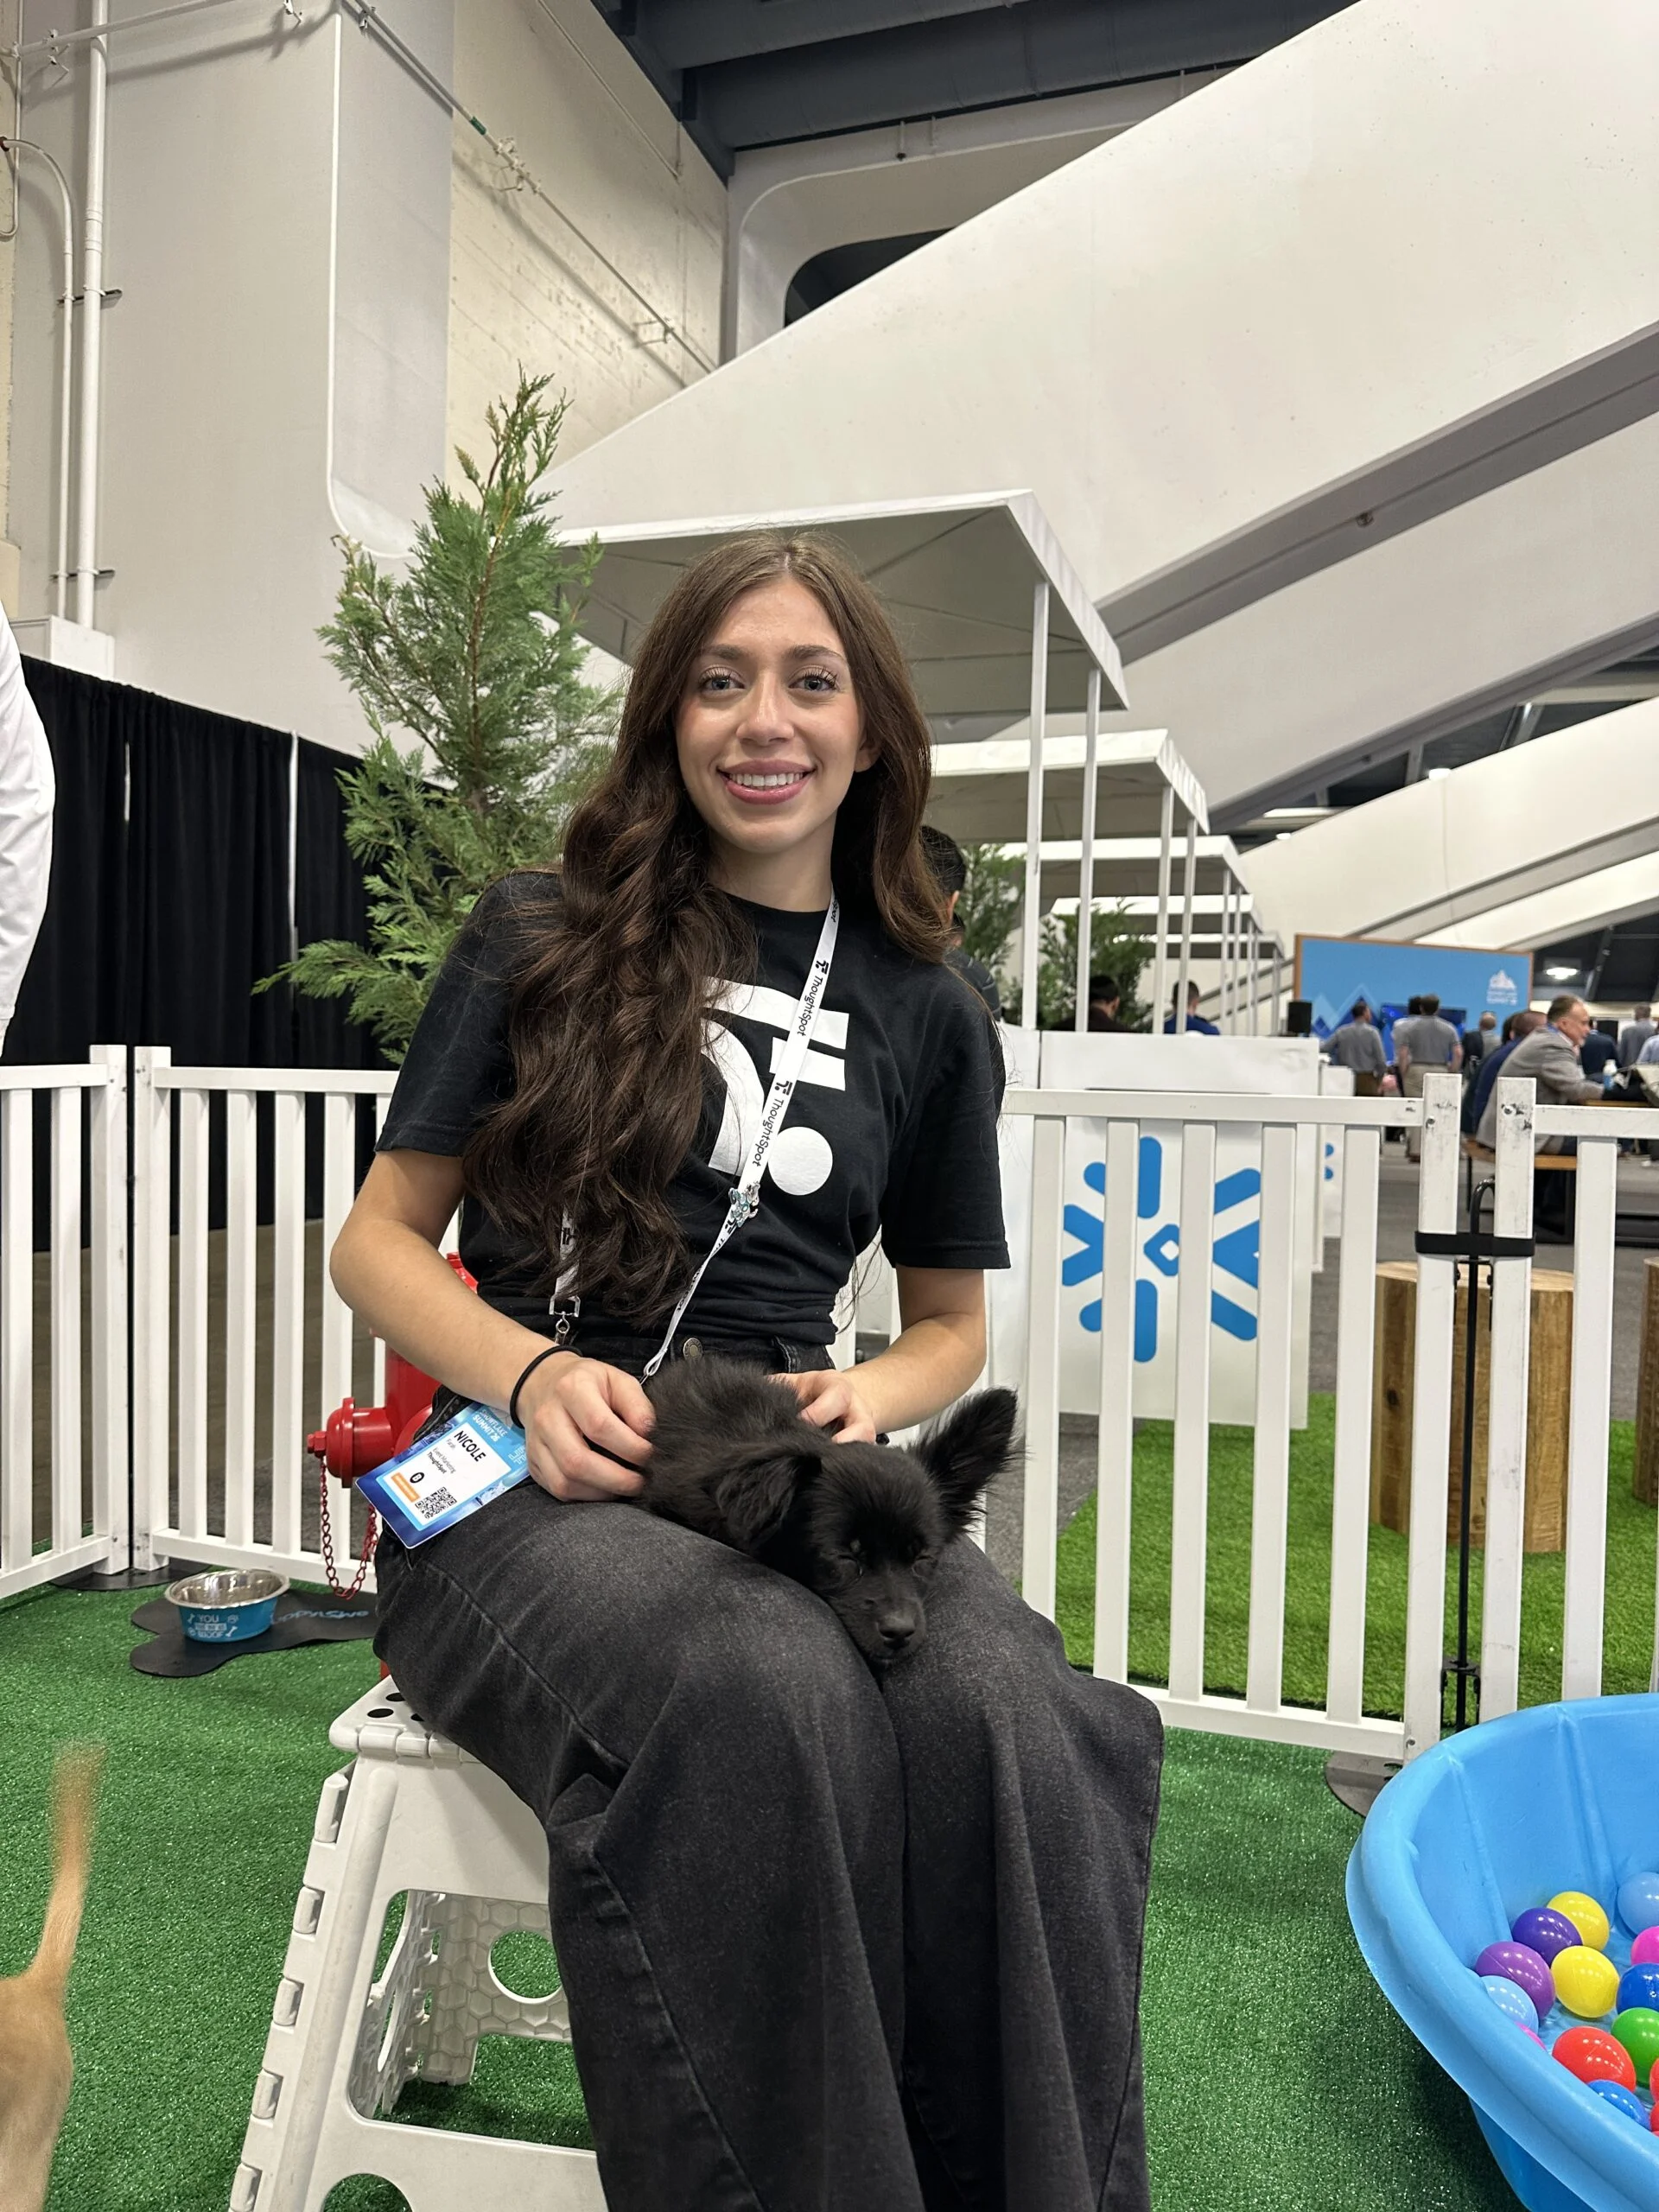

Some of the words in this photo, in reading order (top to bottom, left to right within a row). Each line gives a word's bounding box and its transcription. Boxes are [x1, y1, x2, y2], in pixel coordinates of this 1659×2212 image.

[797, 976, 823, 1037] ThoughtSpot
[752, 1099, 785, 1167] ThoughtSpot
[472, 1414, 495, 1436] SUMMIT
[454, 1430, 486, 1462] NICOLE
[427, 1452, 447, 1473] ThoughtSpot
[199, 1614, 219, 1623] YOU
